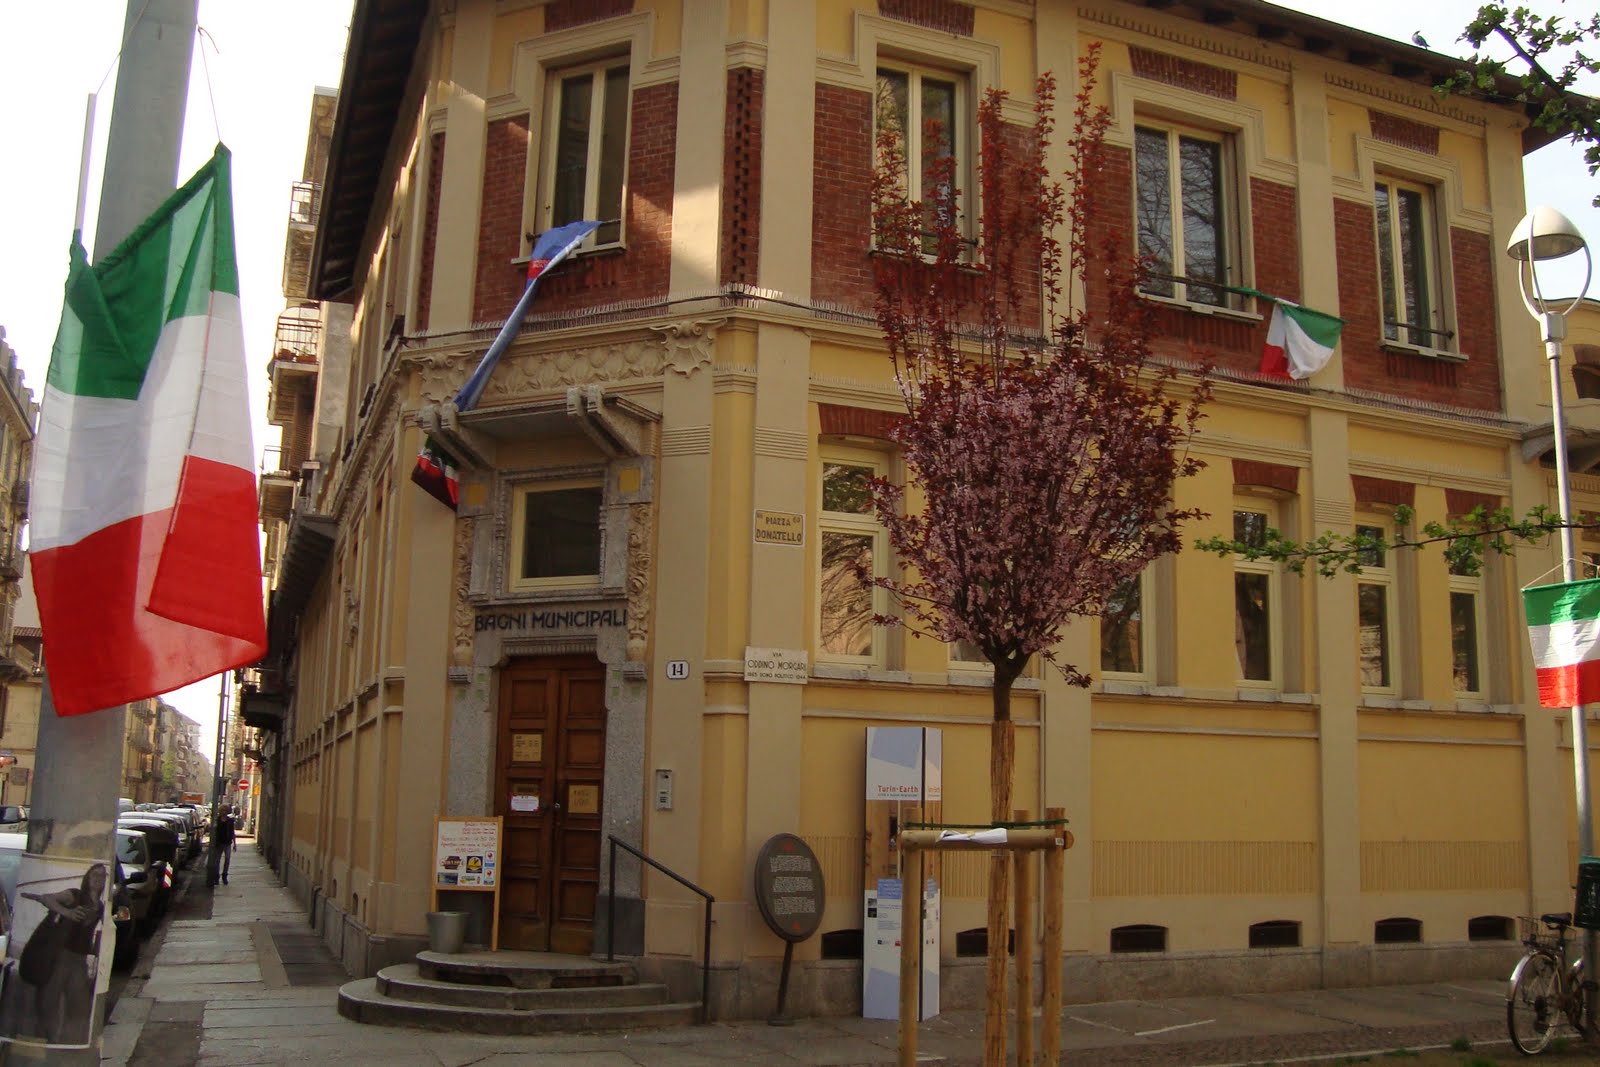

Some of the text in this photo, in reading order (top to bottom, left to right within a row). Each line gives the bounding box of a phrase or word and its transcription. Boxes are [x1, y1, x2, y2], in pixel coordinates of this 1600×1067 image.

[766, 516, 791, 526] PIAZZA
[756, 529, 802, 542] DONATELLO
[475, 609, 628, 632] BAGNI MUNICIPALI
[672, 663, 683, 676] 14
[747, 659, 775, 669] ODDINO
